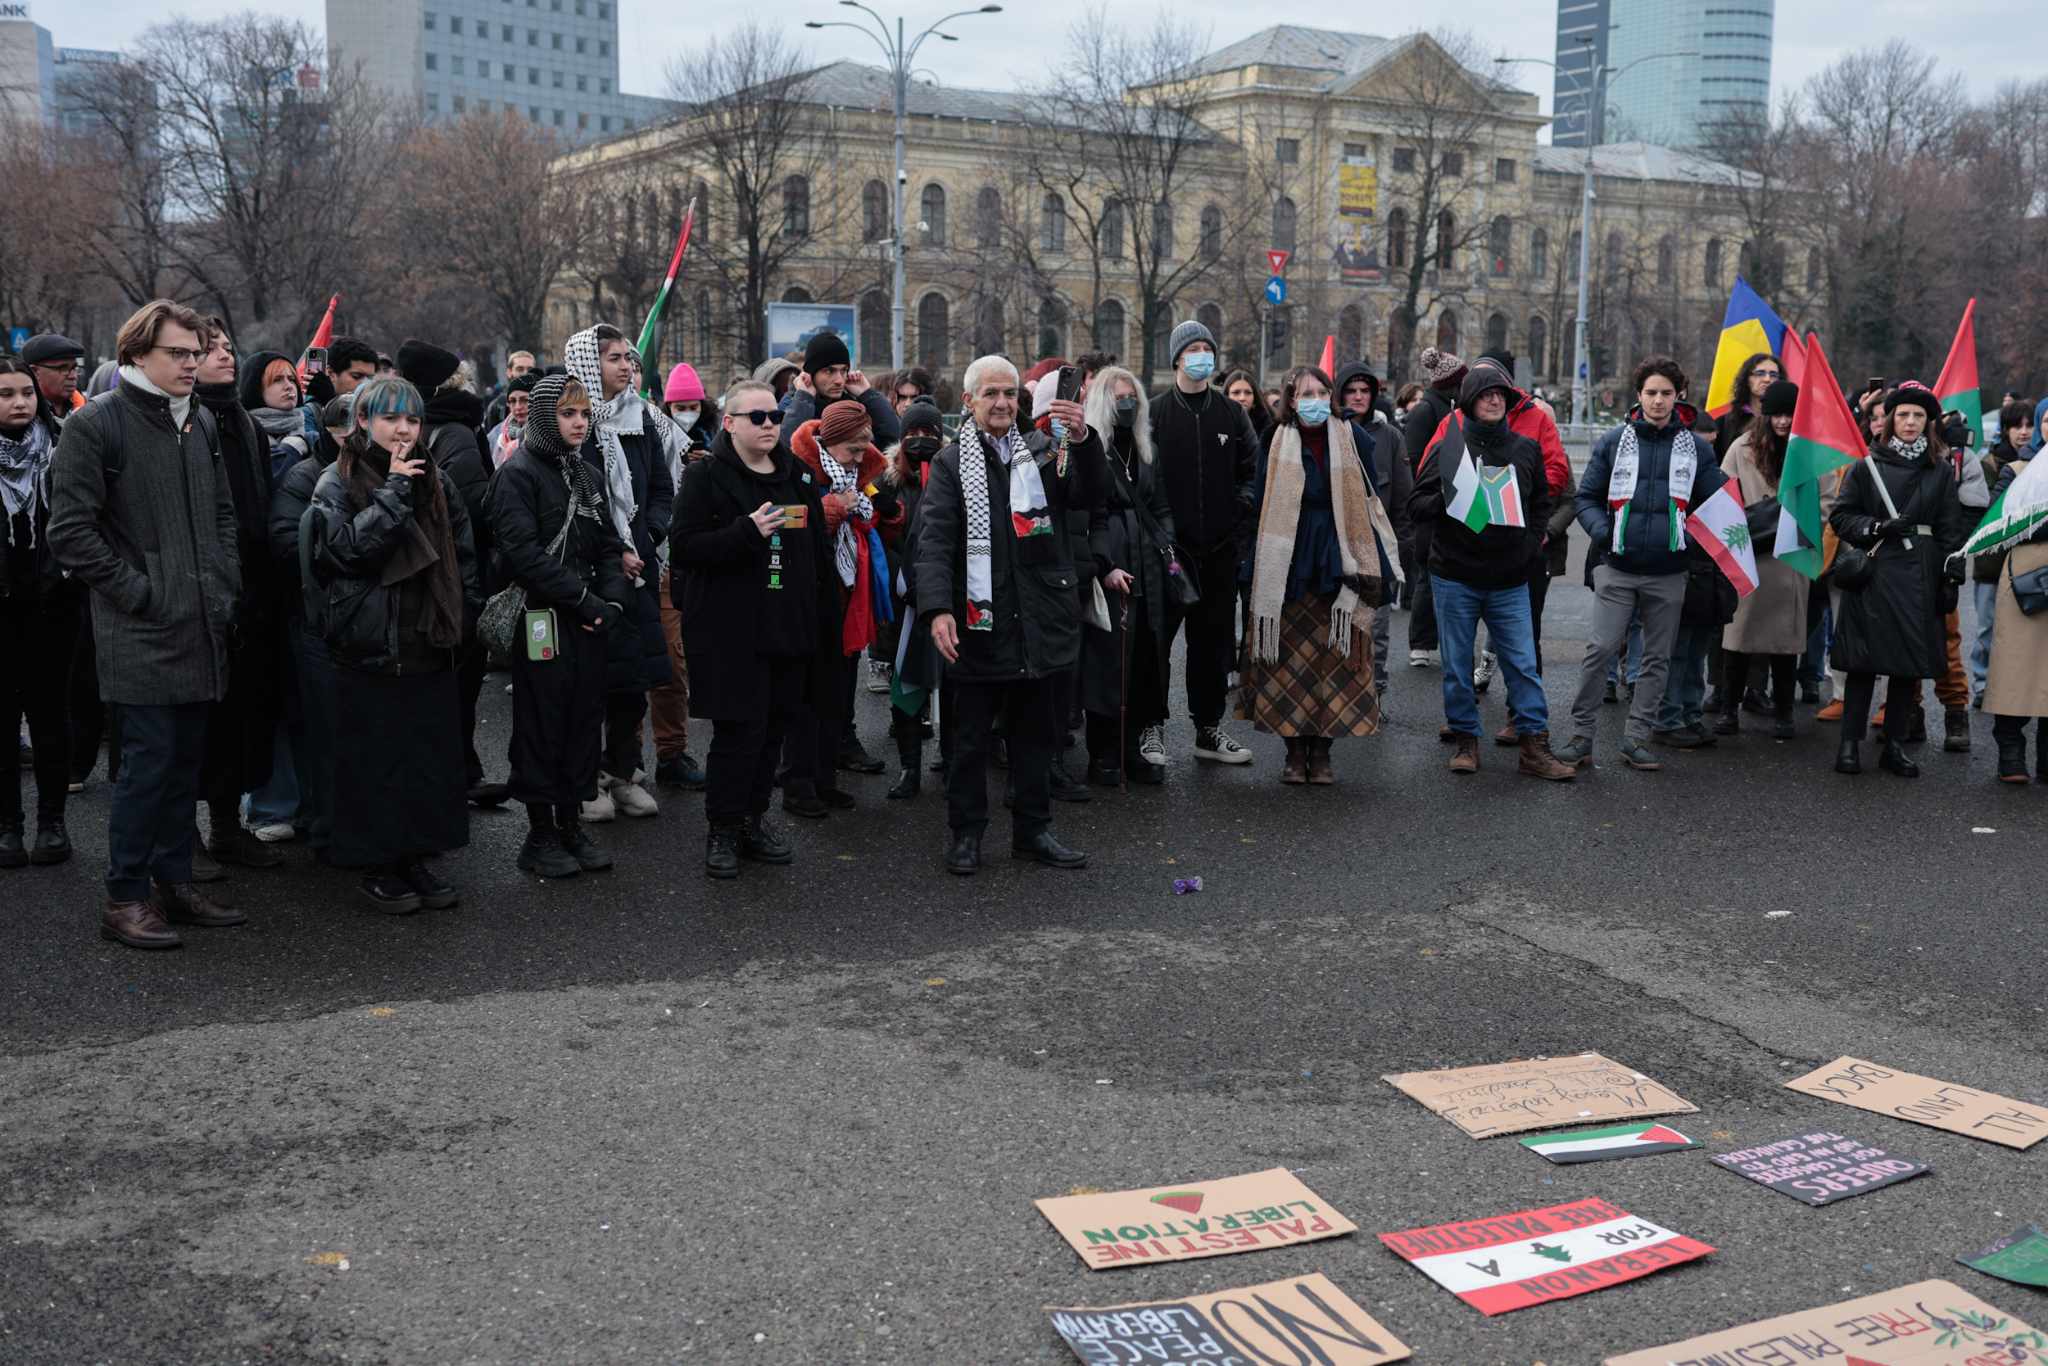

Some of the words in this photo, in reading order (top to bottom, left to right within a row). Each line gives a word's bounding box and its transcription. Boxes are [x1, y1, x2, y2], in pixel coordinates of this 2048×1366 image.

[0, 4, 27, 17] NK
[1807, 1063, 1895, 1099] BACK
[1893, 1087, 1979, 1121] LAND
[1973, 1107, 2044, 1135] ALL
[1740, 1158, 1773, 1172] TO
[1831, 1156, 1850, 1165] A
[1081, 1200, 1318, 1245] LIBERATION
[1087, 1214, 1333, 1263] PALESTINE
[1595, 1223, 1659, 1246] FOR
[1465, 1259, 1502, 1278] A
[1518, 1242, 1693, 1299] LEBANON
[1211, 1283, 1388, 1366] NO
[1834, 1308, 1931, 1346] FREE
[1078, 1332, 1224, 1363] PEACE
